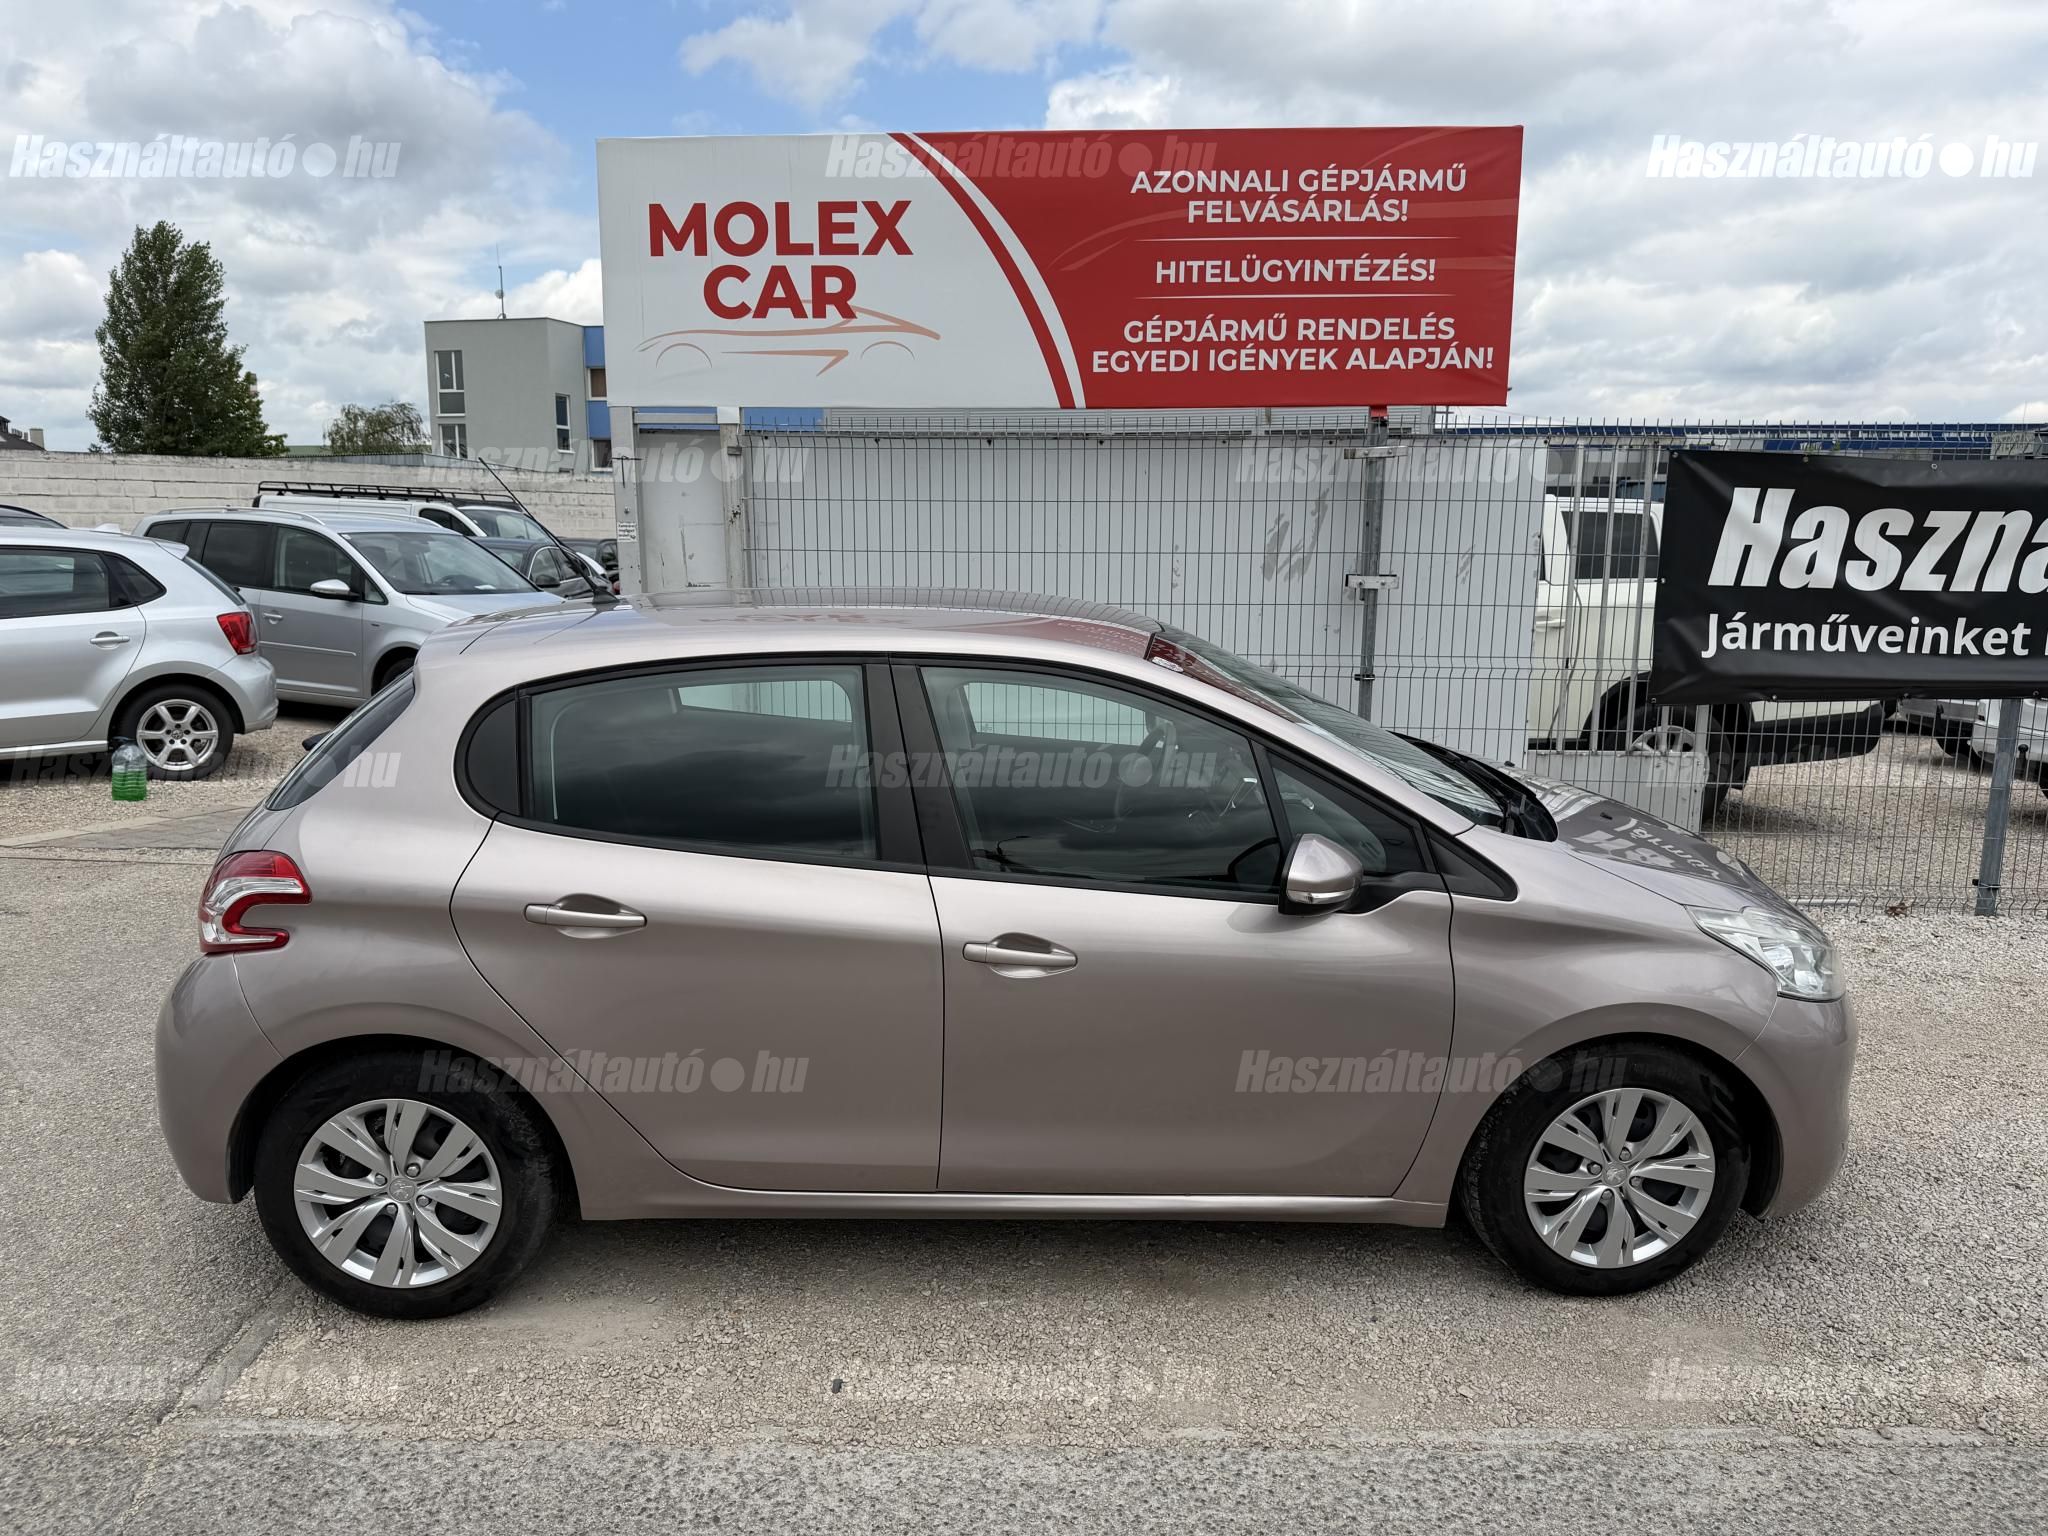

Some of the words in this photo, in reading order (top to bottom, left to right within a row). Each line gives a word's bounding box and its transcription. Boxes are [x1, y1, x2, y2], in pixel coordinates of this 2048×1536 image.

[1130, 168, 1289, 194] AZONNALI
[1298, 162, 1467, 193] GÉPJÁRMŰ
[1187, 193, 1409, 224] FELVÁSÁRLÁS!
[648, 200, 914, 258] MOLEX
[1155, 252, 1437, 284] HITELÜGYINTÉZÉS!
[703, 264, 858, 320] CAR
[1123, 312, 1288, 343] GÉPJÁRMŰ
[1297, 311, 1456, 341] RENDELÉS
[1092, 348, 1199, 374] EGYEDI
[1208, 343, 1338, 371] IGÉNYEK
[1345, 342, 1494, 370] ALAPJÁN!
[1701, 610, 2031, 658] Járműveinket
